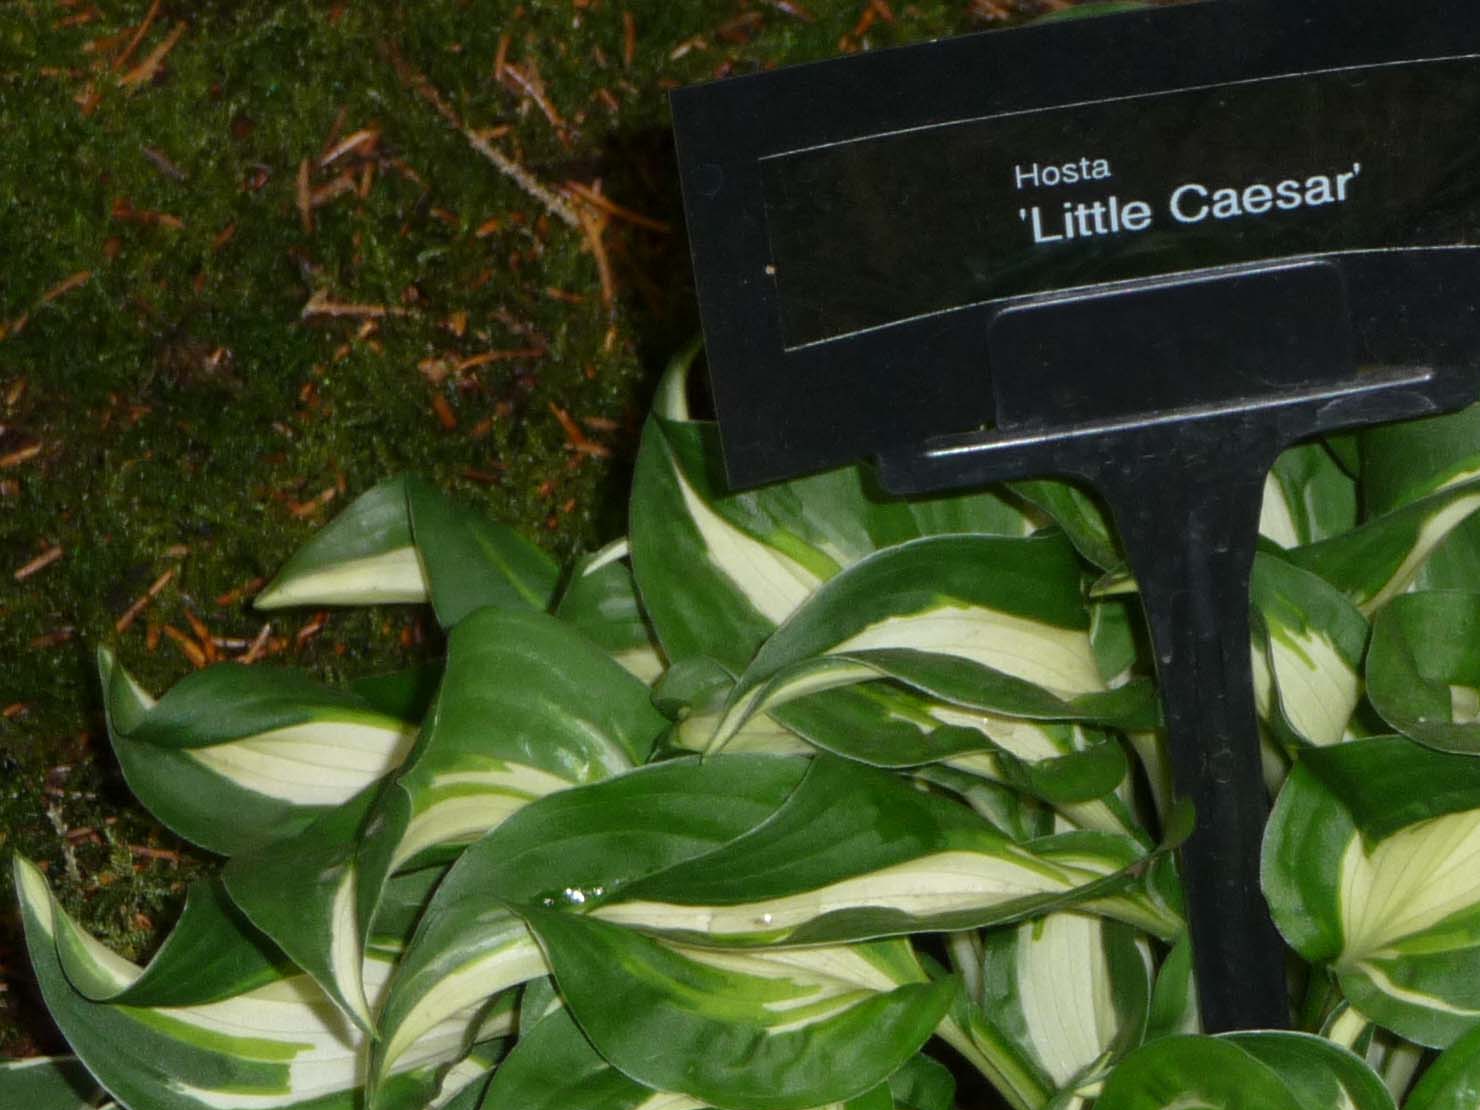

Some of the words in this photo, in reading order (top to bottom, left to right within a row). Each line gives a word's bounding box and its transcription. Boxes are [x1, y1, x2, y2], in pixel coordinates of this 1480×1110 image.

[1015, 156, 1112, 190] Hosta
[1018, 195, 1153, 244] 'Little
[1169, 162, 1361, 224] Caesar'
